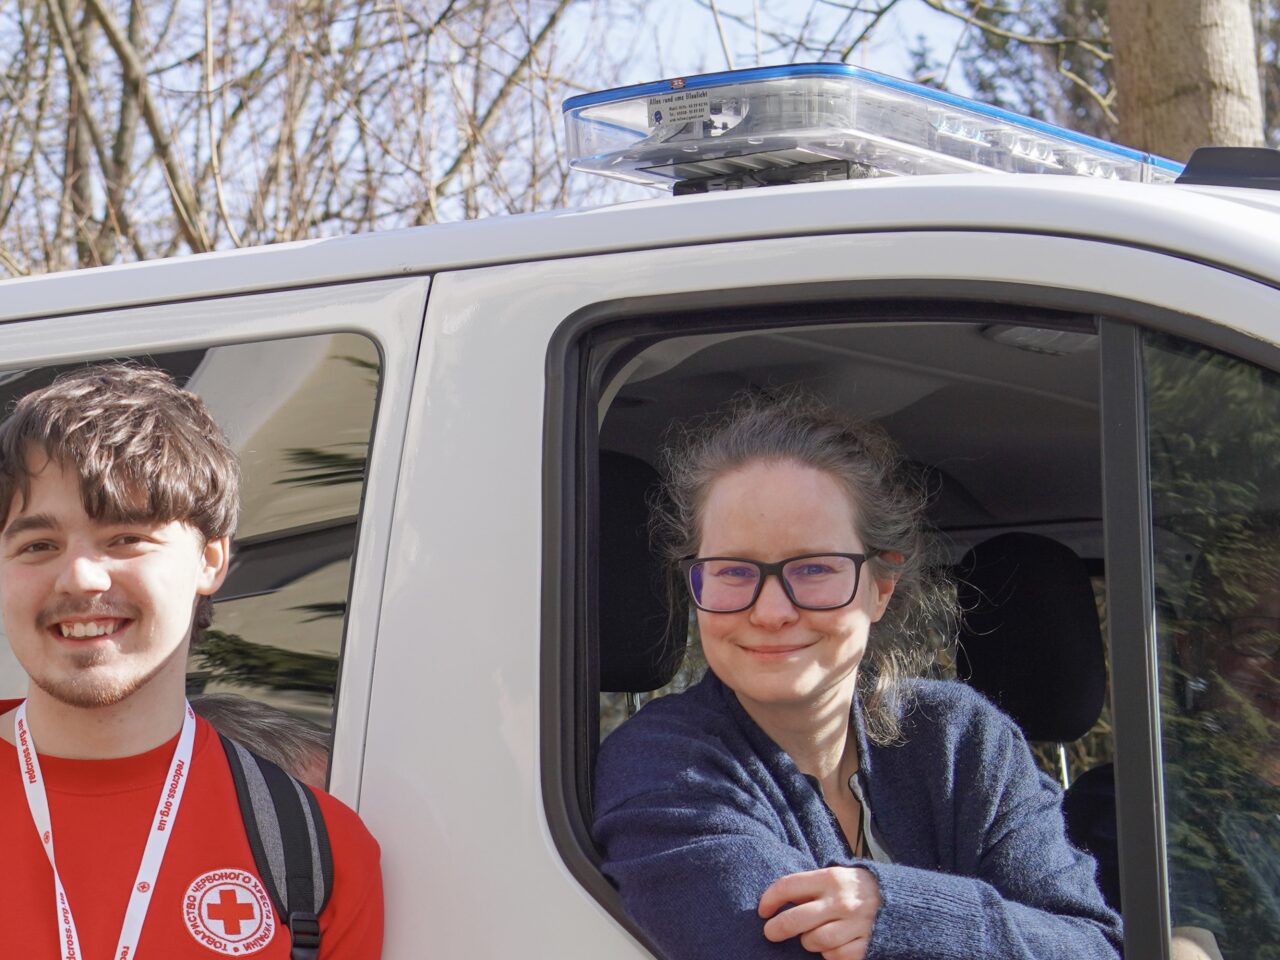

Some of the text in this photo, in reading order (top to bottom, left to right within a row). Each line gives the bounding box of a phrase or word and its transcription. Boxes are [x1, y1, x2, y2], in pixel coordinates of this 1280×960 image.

[17, 718, 37, 784] redcross.org.ua
[157, 759, 185, 831] redcross.org.ua
[186, 871, 273, 951] ТОВАРИСТВО ЧЕРВОНОГО ХРЕСТА УКРАЇНИ
